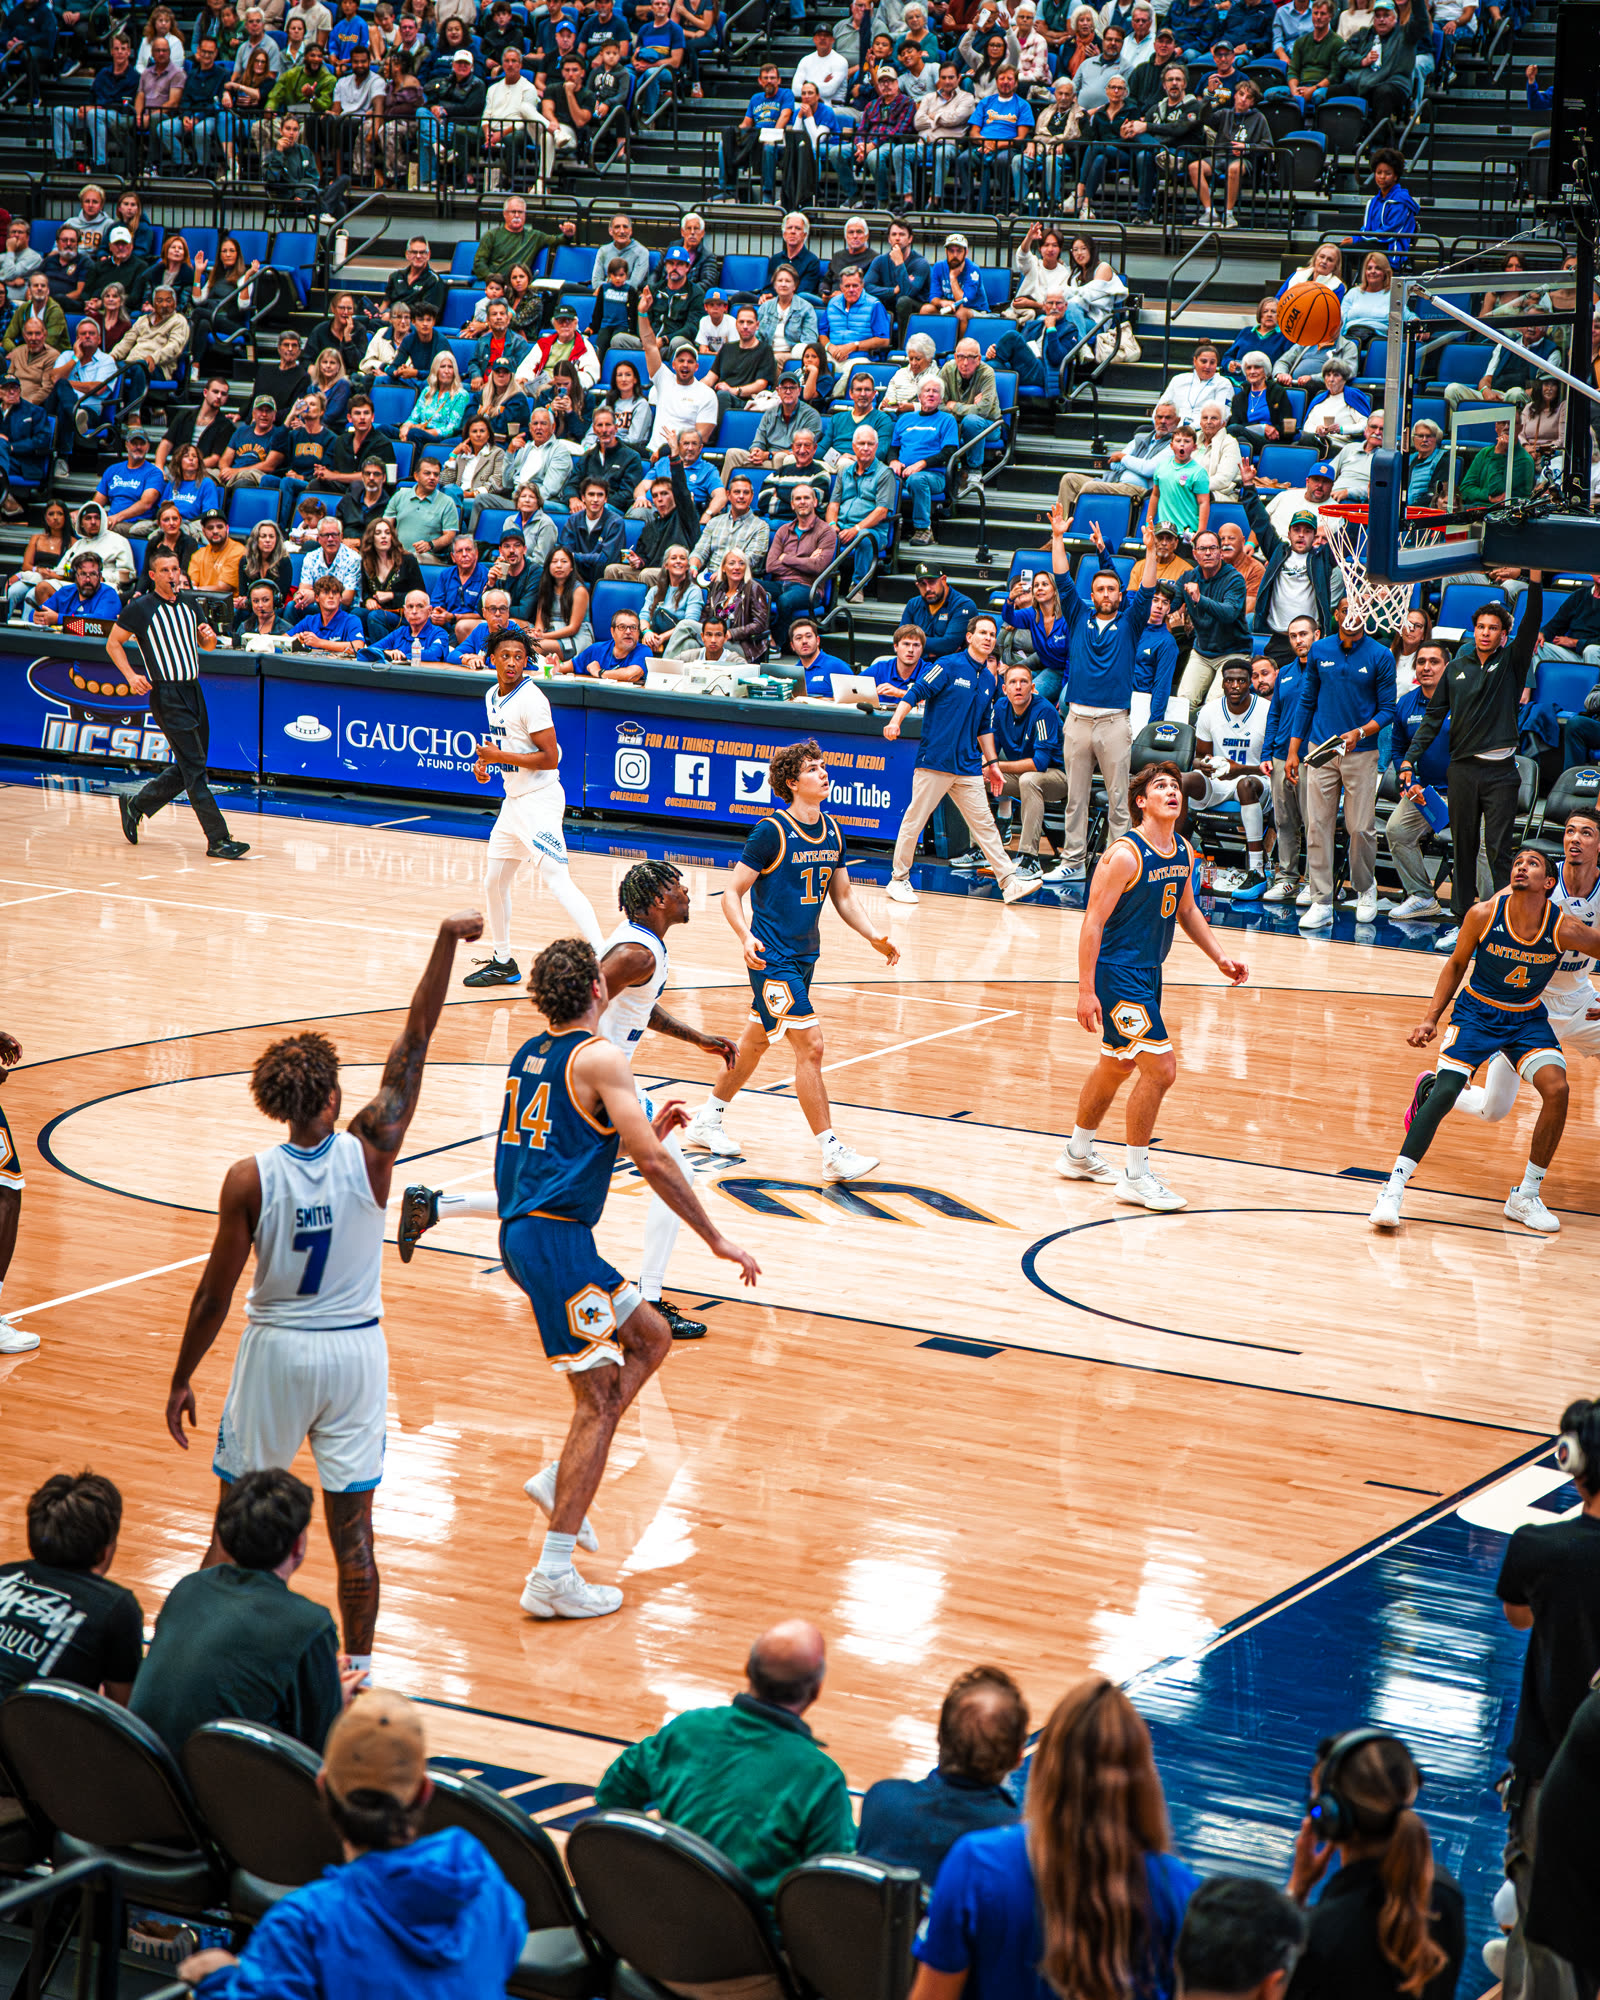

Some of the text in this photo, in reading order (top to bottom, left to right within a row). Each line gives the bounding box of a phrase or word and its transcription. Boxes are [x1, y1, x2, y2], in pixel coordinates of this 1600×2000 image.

[1285, 308, 1301, 333] NCAA
[295, 442, 323, 460] UCSB
[84, 622, 104, 635] POSS.
[45, 719, 172, 763] UCSB
[644, 733, 663, 747] FOR
[663, 734, 679, 750] ALL
[681, 737, 715, 753] THINGS
[716, 740, 754, 757] GAUCHO
[822, 751, 854, 768] SOCIAL
[855, 755, 886, 771] MEDIA
[1222, 737, 1251, 748] SANTA
[417, 757, 425, 768] A
[427, 758, 454, 770] FUND
[610, 790, 650, 804] @OLEGAUCHO
[664, 796, 717, 811] @UCSBATHLETICS
[800, 866, 833, 905] 13
[1160, 882, 1178, 919] 6
[1485, 942, 1557, 965] ANTEATERS
[1503, 965, 1531, 988] 4
[501, 1075, 553, 1150] 14
[296, 1204, 333, 1228] SMITH
[292, 1227, 333, 1296] 7
